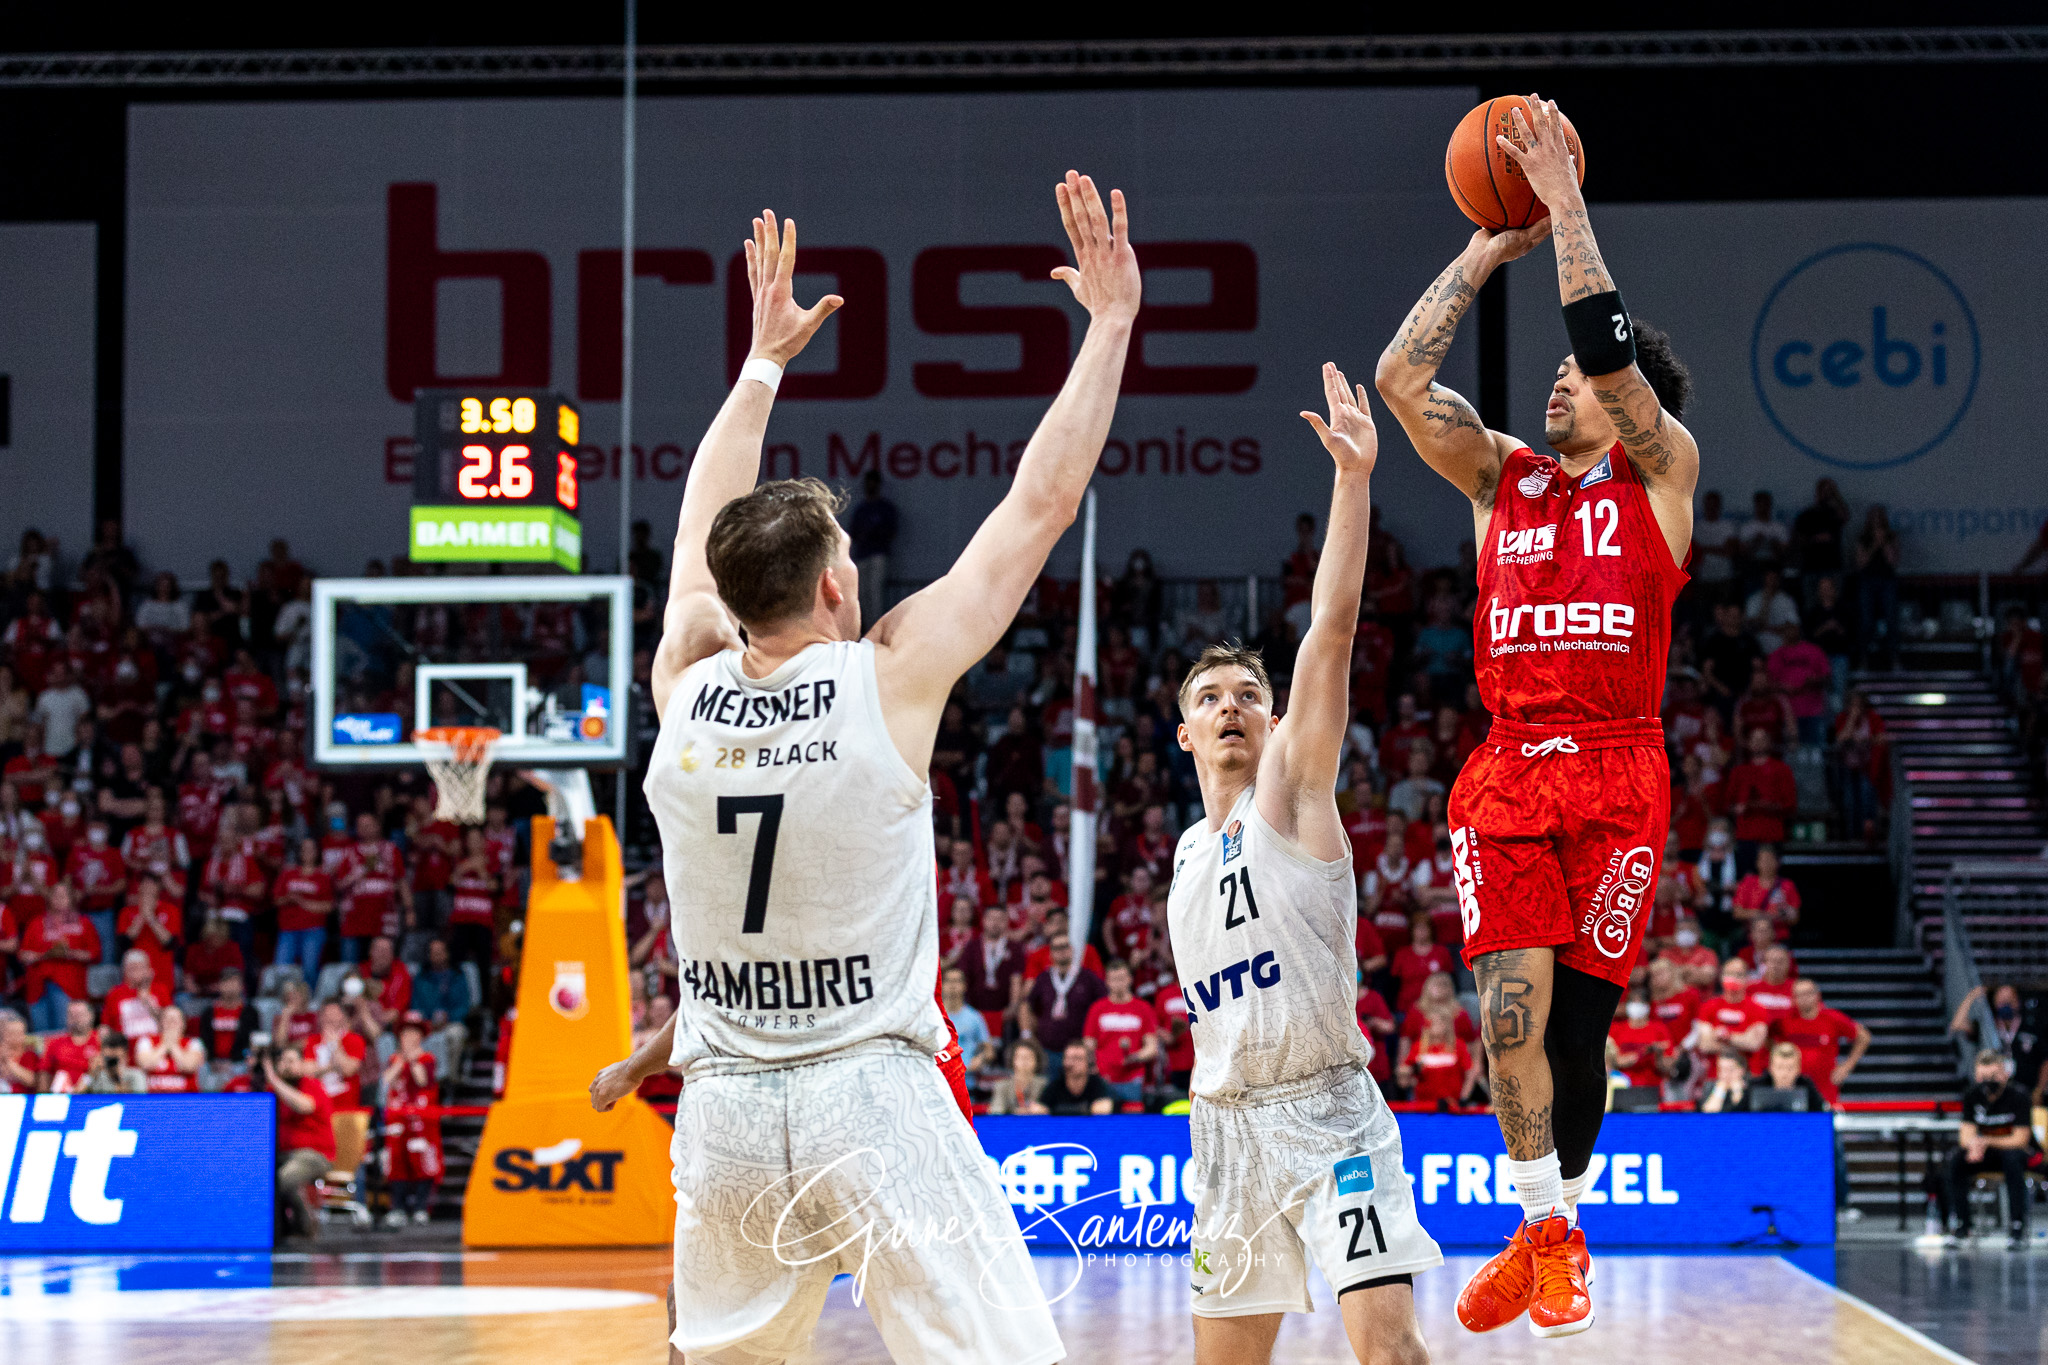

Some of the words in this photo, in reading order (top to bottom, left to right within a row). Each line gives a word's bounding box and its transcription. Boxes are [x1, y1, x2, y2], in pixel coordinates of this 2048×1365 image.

[385, 182, 1259, 402] brose
[1773, 305, 1947, 388] cebi
[458, 444, 534, 498] 2.6
[415, 521, 551, 548] BARMER
[1574, 499, 1622, 557] 12
[1489, 597, 1635, 642] brose
[1540, 641, 1551, 652] in
[691, 679, 836, 728] MEISNER
[715, 747, 746, 769] 28
[757, 741, 838, 768] BLACK
[717, 793, 784, 934] 7
[1472, 860, 1484, 886] rent
[1580, 847, 1624, 935] AUTOMATION
[1220, 865, 1260, 931] 21
[683, 954, 874, 1010] HAMBURG
[1194, 950, 1282, 1012] VTG
[1338, 1204, 1388, 1263] 21
